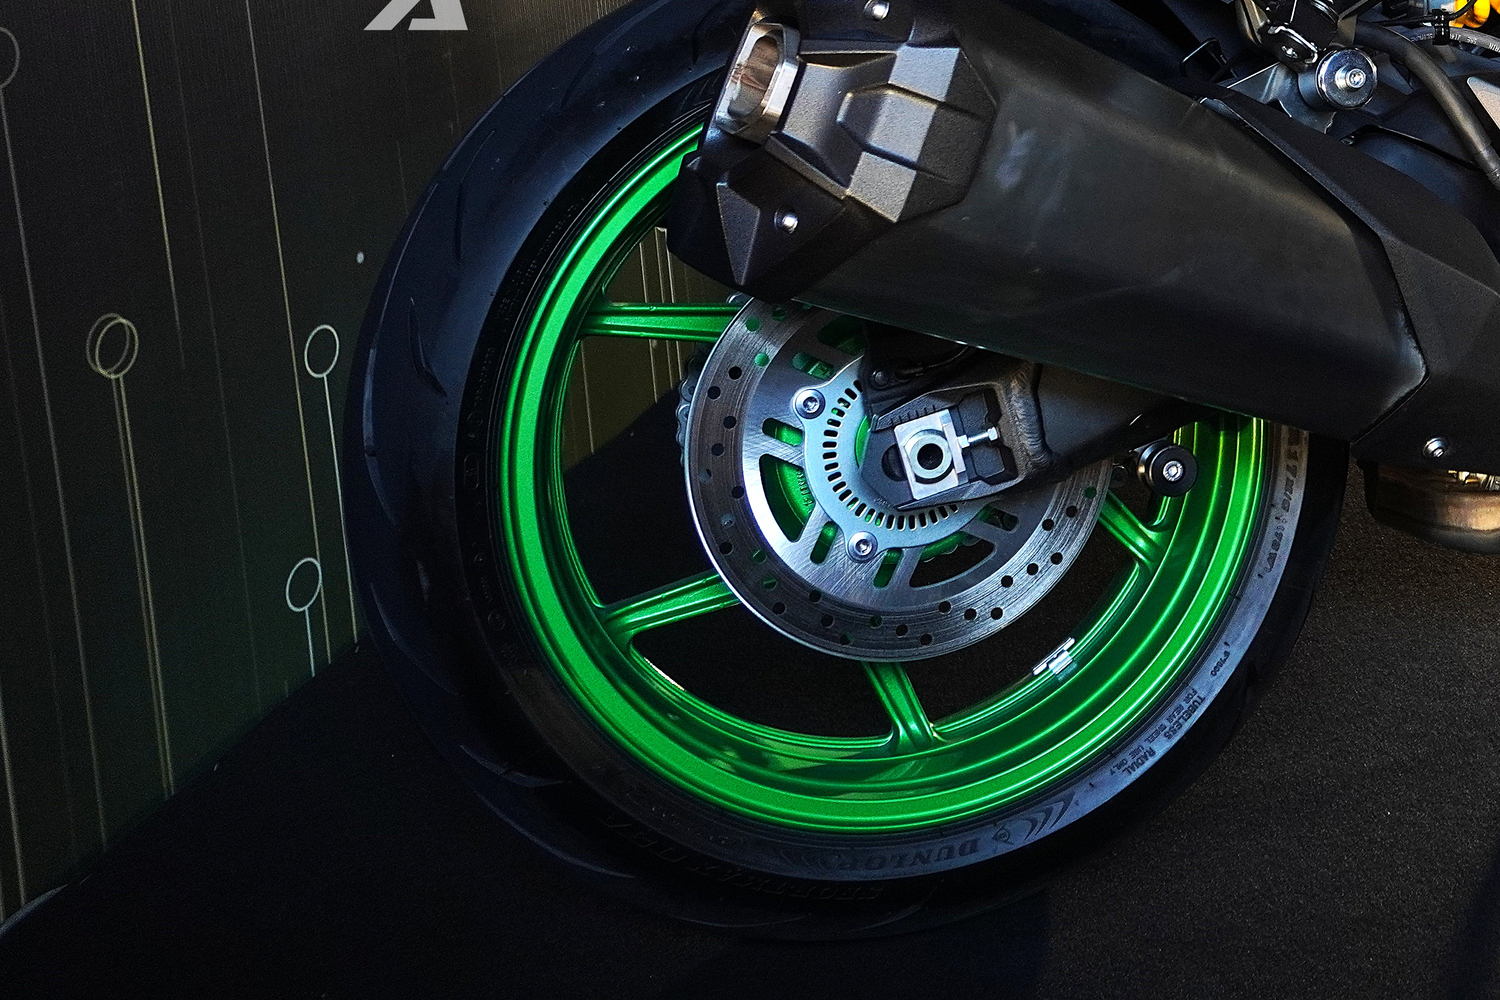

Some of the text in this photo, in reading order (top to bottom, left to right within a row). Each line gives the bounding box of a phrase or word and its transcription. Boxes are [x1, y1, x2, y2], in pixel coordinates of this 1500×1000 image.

[1182, 688, 1198, 704] FOR
[1165, 704, 1185, 724] REAR
[1121, 694, 1206, 775] TUBELESS RADIAL
[838, 838, 979, 871] DUNLOP
